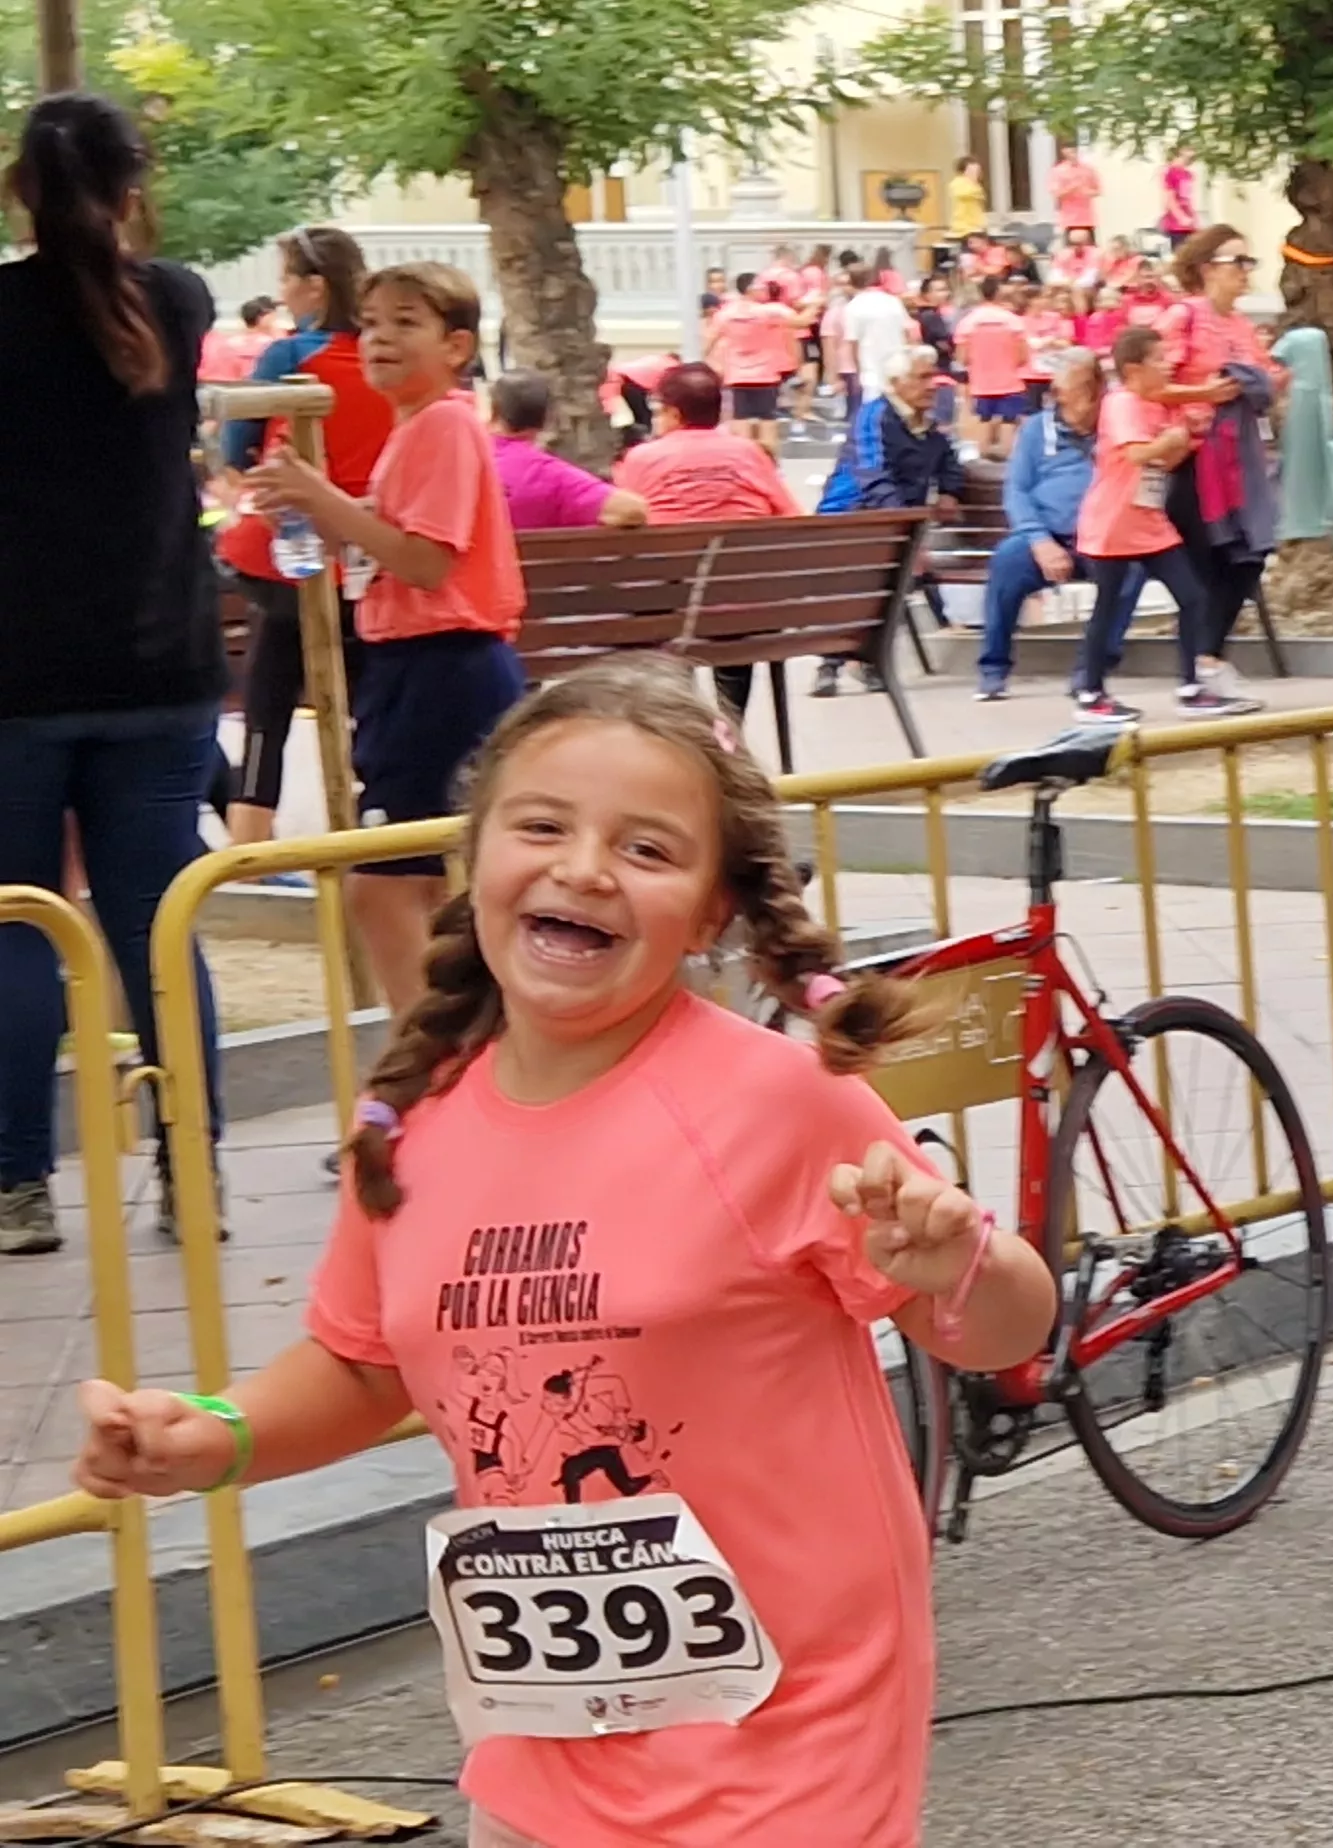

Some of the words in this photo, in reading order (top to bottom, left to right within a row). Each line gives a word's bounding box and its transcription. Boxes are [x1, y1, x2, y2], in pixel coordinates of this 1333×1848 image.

[463, 1220, 588, 1278] CORRAMOS
[435, 1280, 481, 1333] POR
[486, 1278, 510, 1328] LA
[516, 1271, 602, 1326] CIENCIA
[455, 1550, 562, 1577] CONTRA
[574, 1549, 609, 1574] EL
[611, 1538, 690, 1570] CÁN
[541, 1526, 628, 1551] HUESCA
[462, 1574, 749, 1674] 3393
